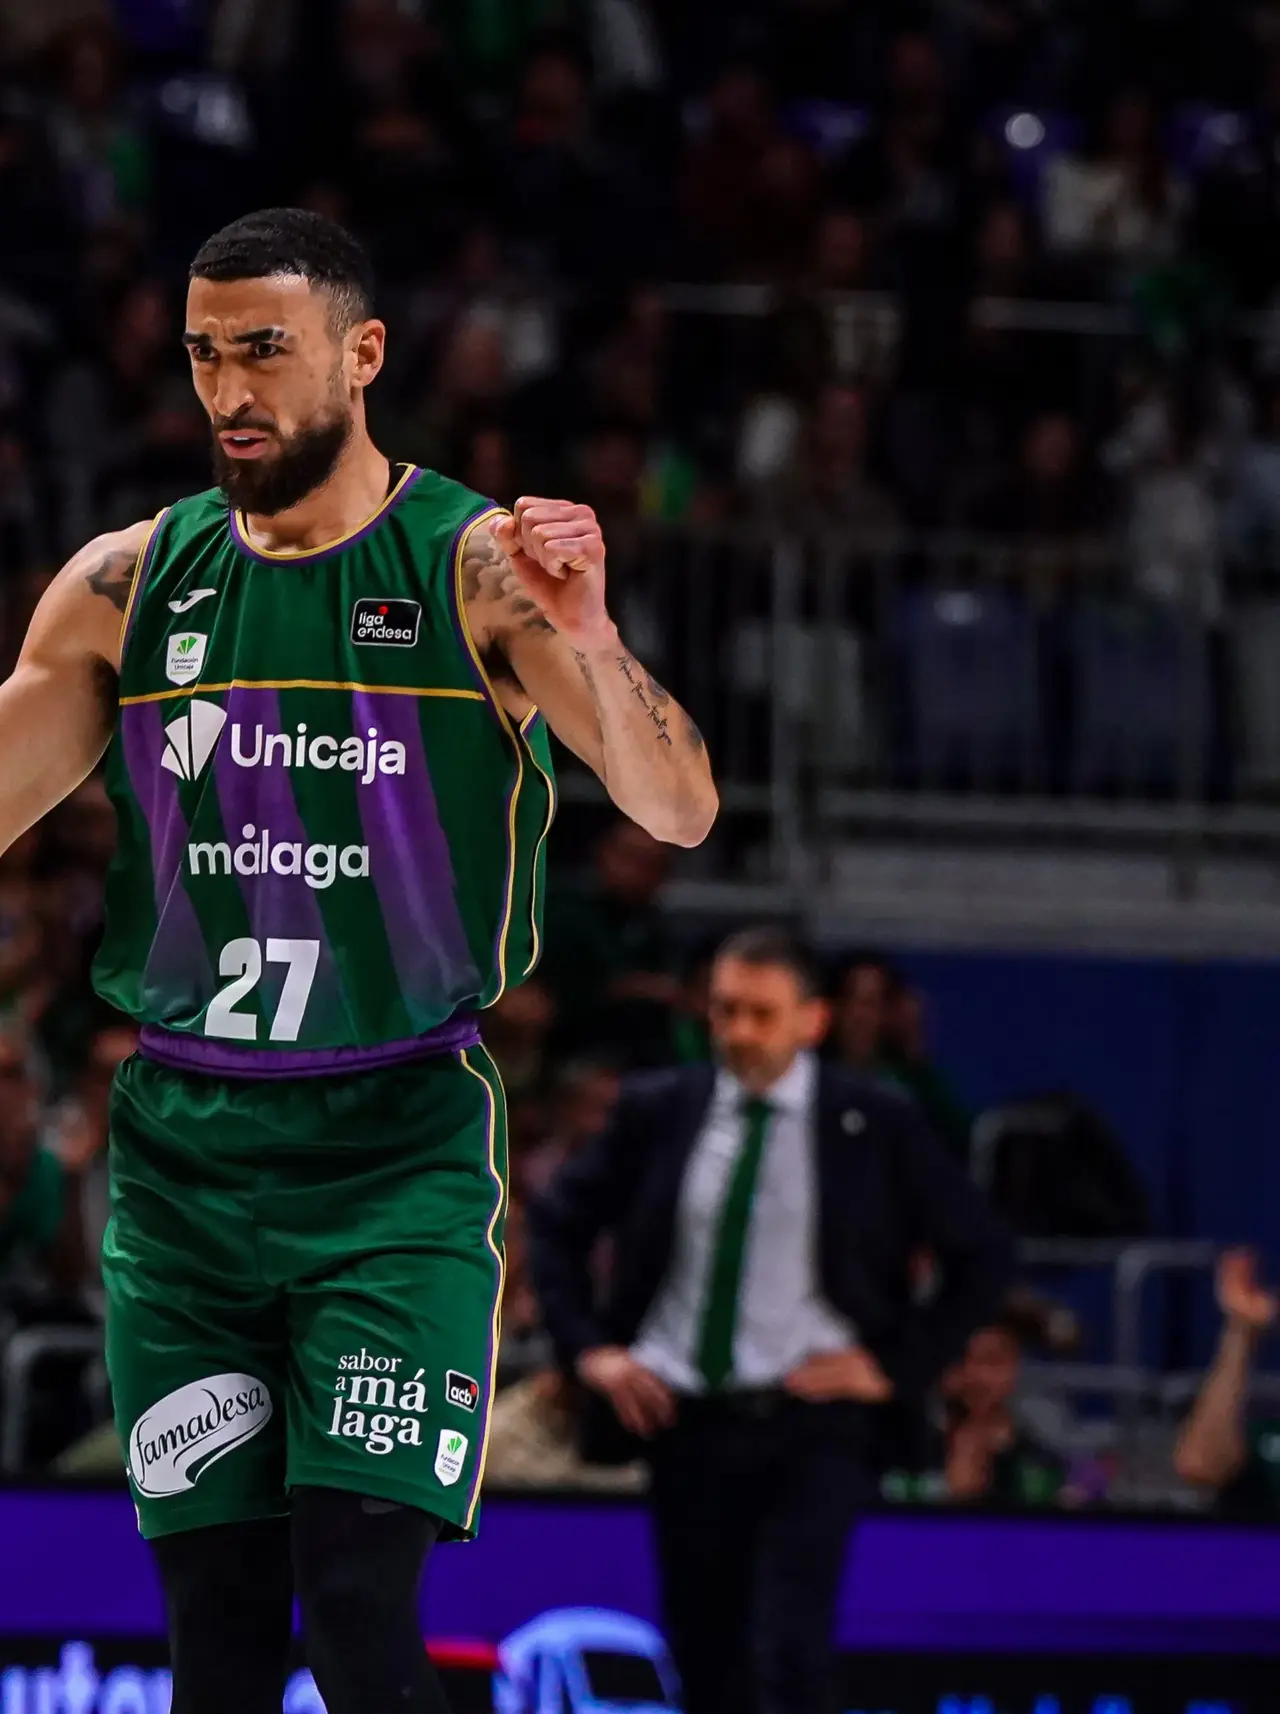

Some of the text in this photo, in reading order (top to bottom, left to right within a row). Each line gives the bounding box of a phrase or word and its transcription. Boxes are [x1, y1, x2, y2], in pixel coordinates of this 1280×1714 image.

[358, 611, 384, 627] liga
[357, 625, 412, 640] endesa
[231, 723, 406, 784] Unicaja
[204, 937, 320, 1041] 27
[337, 1347, 402, 1373] sabor
[335, 1375, 347, 1391] a
[450, 1386, 472, 1406] acb
[327, 1396, 423, 1455] laga
